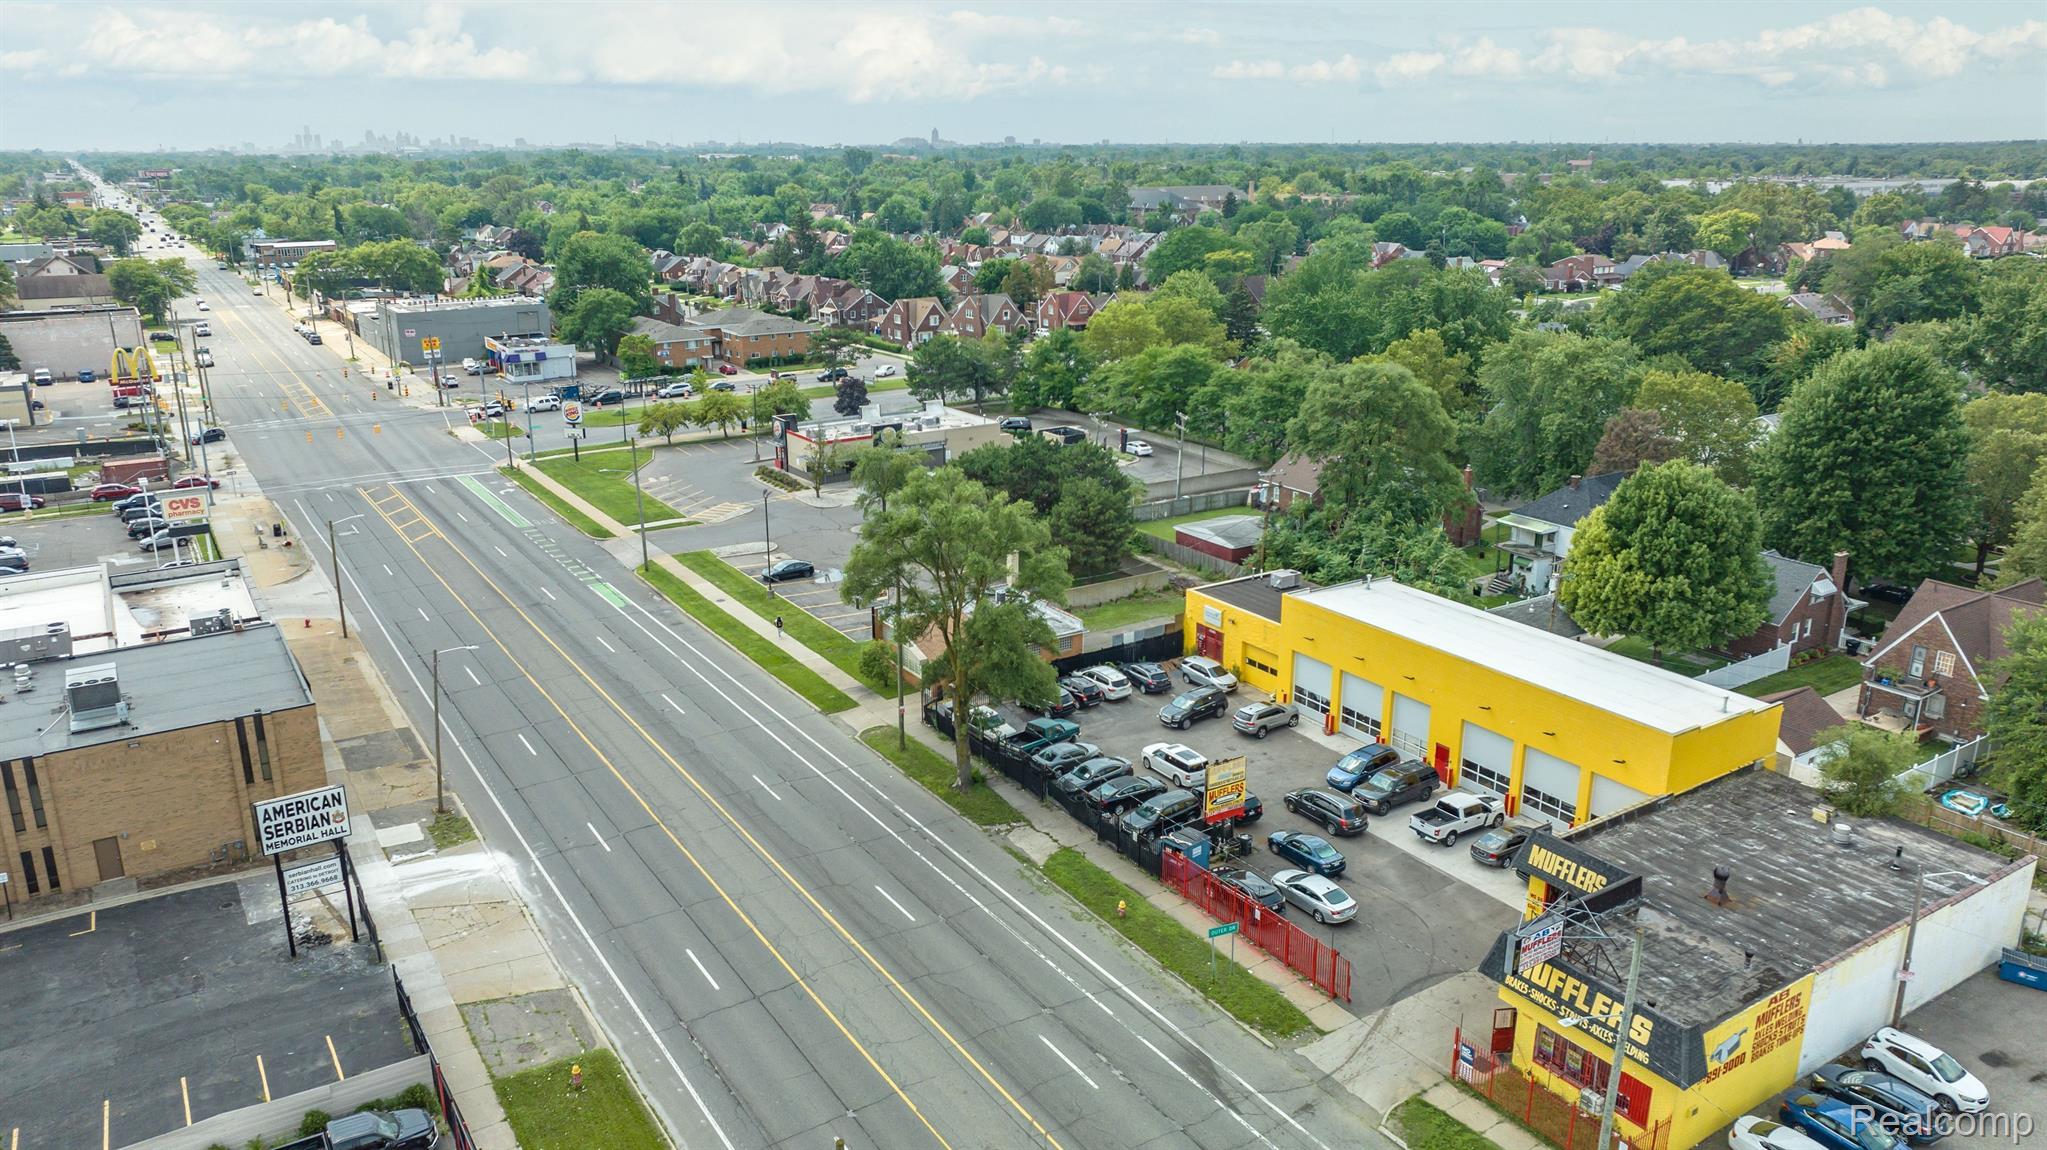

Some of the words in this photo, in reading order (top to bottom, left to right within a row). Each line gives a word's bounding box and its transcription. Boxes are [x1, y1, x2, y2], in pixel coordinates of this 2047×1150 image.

[168, 497, 201, 510] CVS
[168, 509, 205, 518] pharmacy
[1209, 782, 1244, 802] MUFFLERS
[262, 791, 342, 824] AMERICAN
[263, 811, 331, 841] SERBIAN
[265, 832, 318, 852] MEMORIAL
[320, 825, 347, 838] HALL
[287, 862, 337, 879] serbianhall.com
[1527, 843, 1608, 894] MUFFLERS
[1521, 930, 1562, 955] MUFFLERS
[1533, 928, 1550, 941] AB
[1754, 991, 1803, 1031] MUFFLERS
[1767, 988, 1791, 1008] AB
[1504, 975, 1528, 994] BRAKES
[1530, 988, 1557, 1011] SHOCKS
[1590, 1023, 1614, 1043] AXLES
[1616, 1033, 1650, 1064] ELDING
[1751, 1029, 1778, 1053] SHOCKS
[1777, 1013, 1806, 1037] STRUTS
[1754, 1022, 1774, 1041] AXLES
[1774, 1006, 1804, 1029] WELDING
